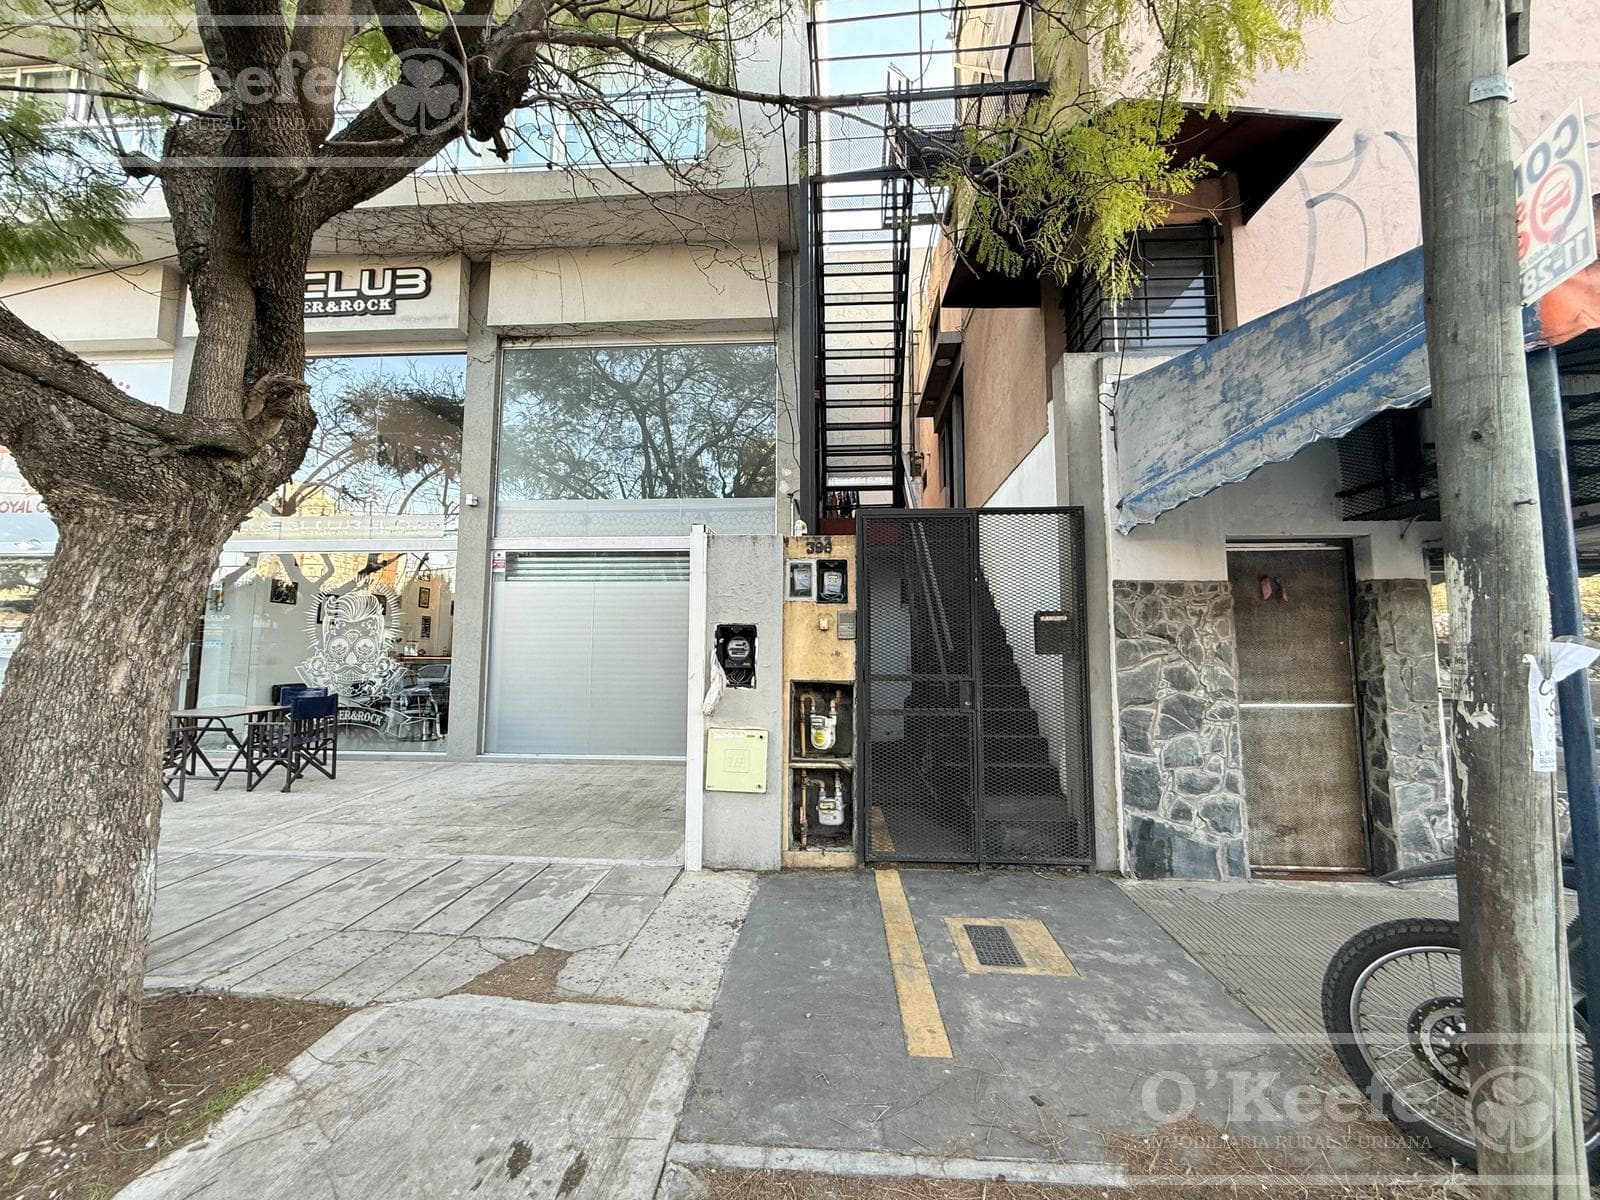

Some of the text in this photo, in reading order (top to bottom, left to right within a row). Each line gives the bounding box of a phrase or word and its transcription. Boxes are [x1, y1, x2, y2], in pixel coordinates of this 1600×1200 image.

[304, 299, 392, 313] ER&ROCK
[0, 500, 32, 513] OYAL
[339, 709, 383, 726] ER&ROCK
